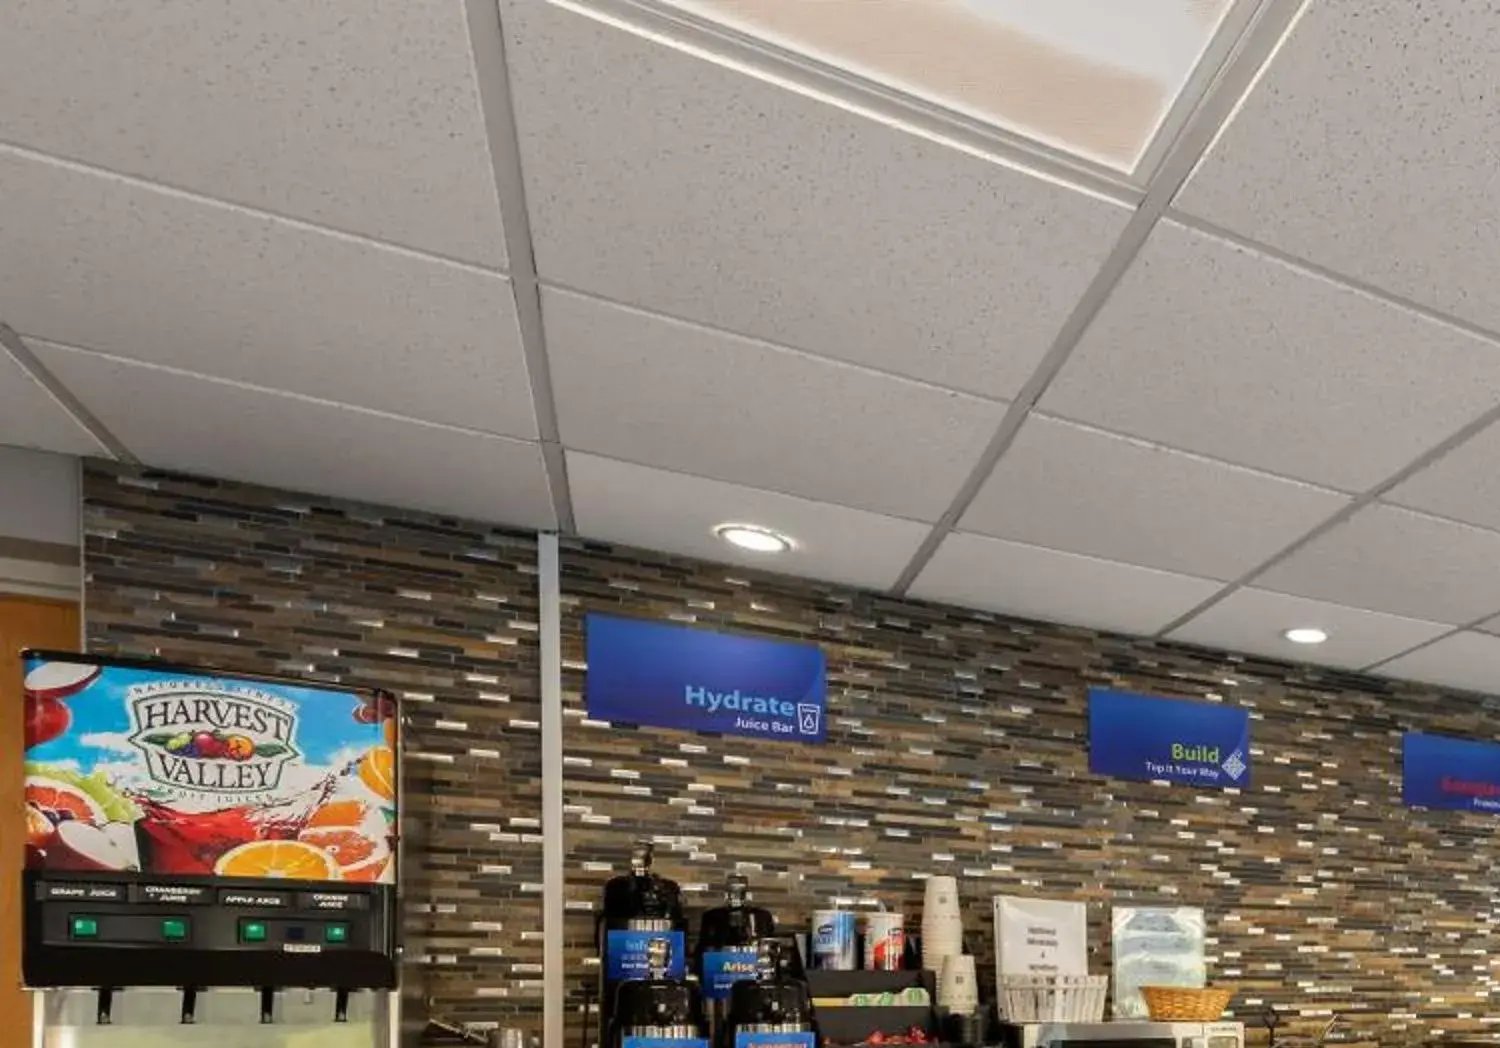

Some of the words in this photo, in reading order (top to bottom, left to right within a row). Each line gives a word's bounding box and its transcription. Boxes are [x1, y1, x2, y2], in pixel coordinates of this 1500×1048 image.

[684, 685, 795, 717] Hydrate
[143, 698, 289, 741] HARVEST
[735, 716, 769, 732] Juice
[771, 722, 795, 734] Bar
[1171, 742, 1219, 764] Build
[157, 752, 273, 789] VALLEY
